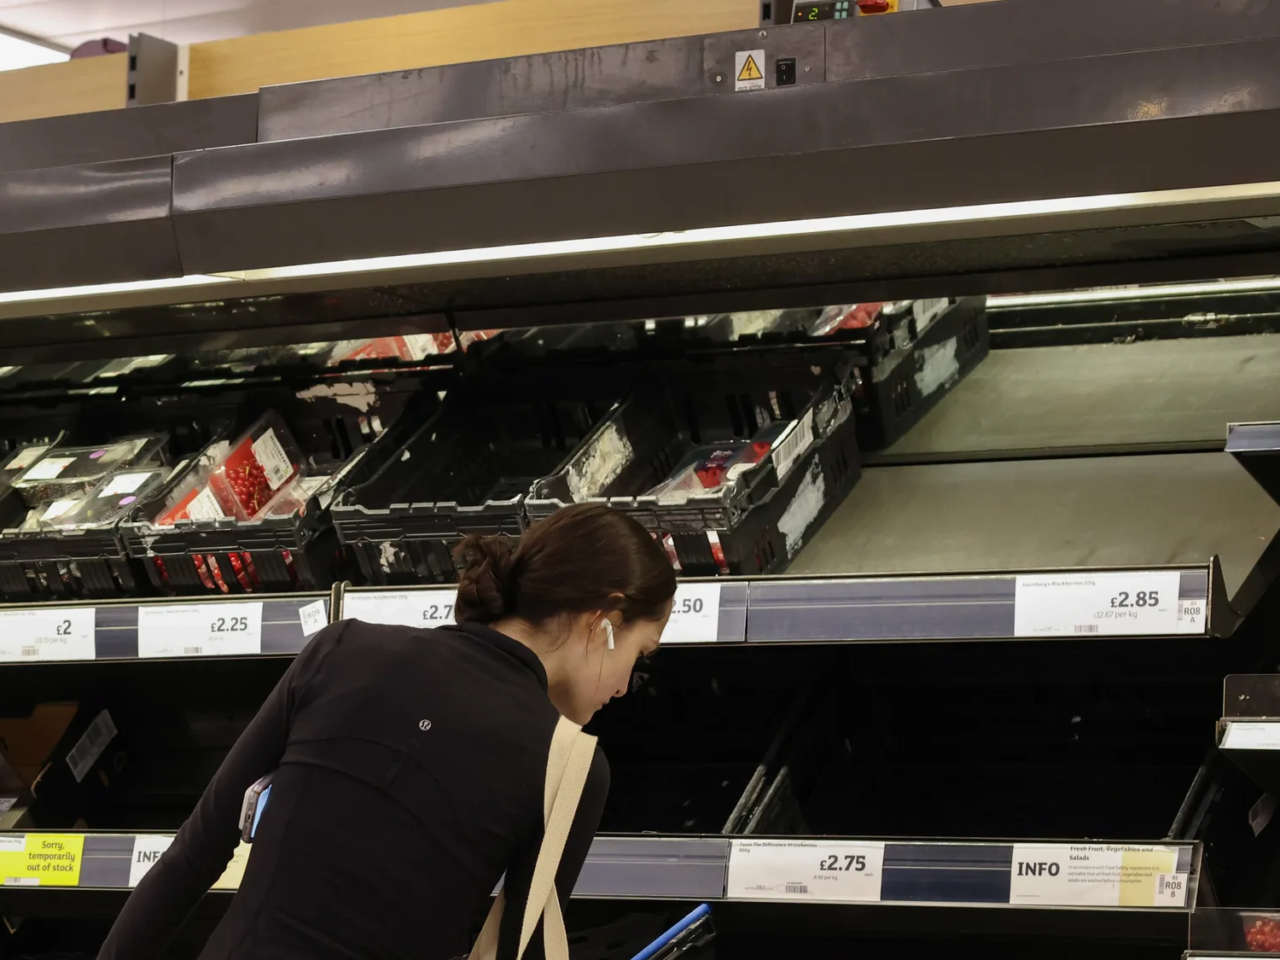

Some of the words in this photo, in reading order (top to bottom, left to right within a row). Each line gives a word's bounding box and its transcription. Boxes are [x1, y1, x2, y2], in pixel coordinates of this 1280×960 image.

[1110, 591, 1160, 608] £2.85
[422, 604, 454, 620] £2.7
[1115, 612, 1127, 620] per
[1128, 610, 1138, 619] kg
[1183, 607, 1201, 616] R08
[210, 616, 248, 633] £2.25
[1189, 616, 1196, 624] A
[56, 619, 72, 636] £2
[41, 840, 65, 851] Sorry,
[28, 852, 76, 862] temporarily
[136, 850, 166, 863] INF
[26, 864, 40, 872] out
[41, 862, 51, 872] of
[52, 862, 74, 872] stock
[819, 855, 866, 871] £2.75
[1017, 862, 1060, 877] INFO
[1165, 881, 1182, 890] R08
[1170, 890, 1176, 898] B
